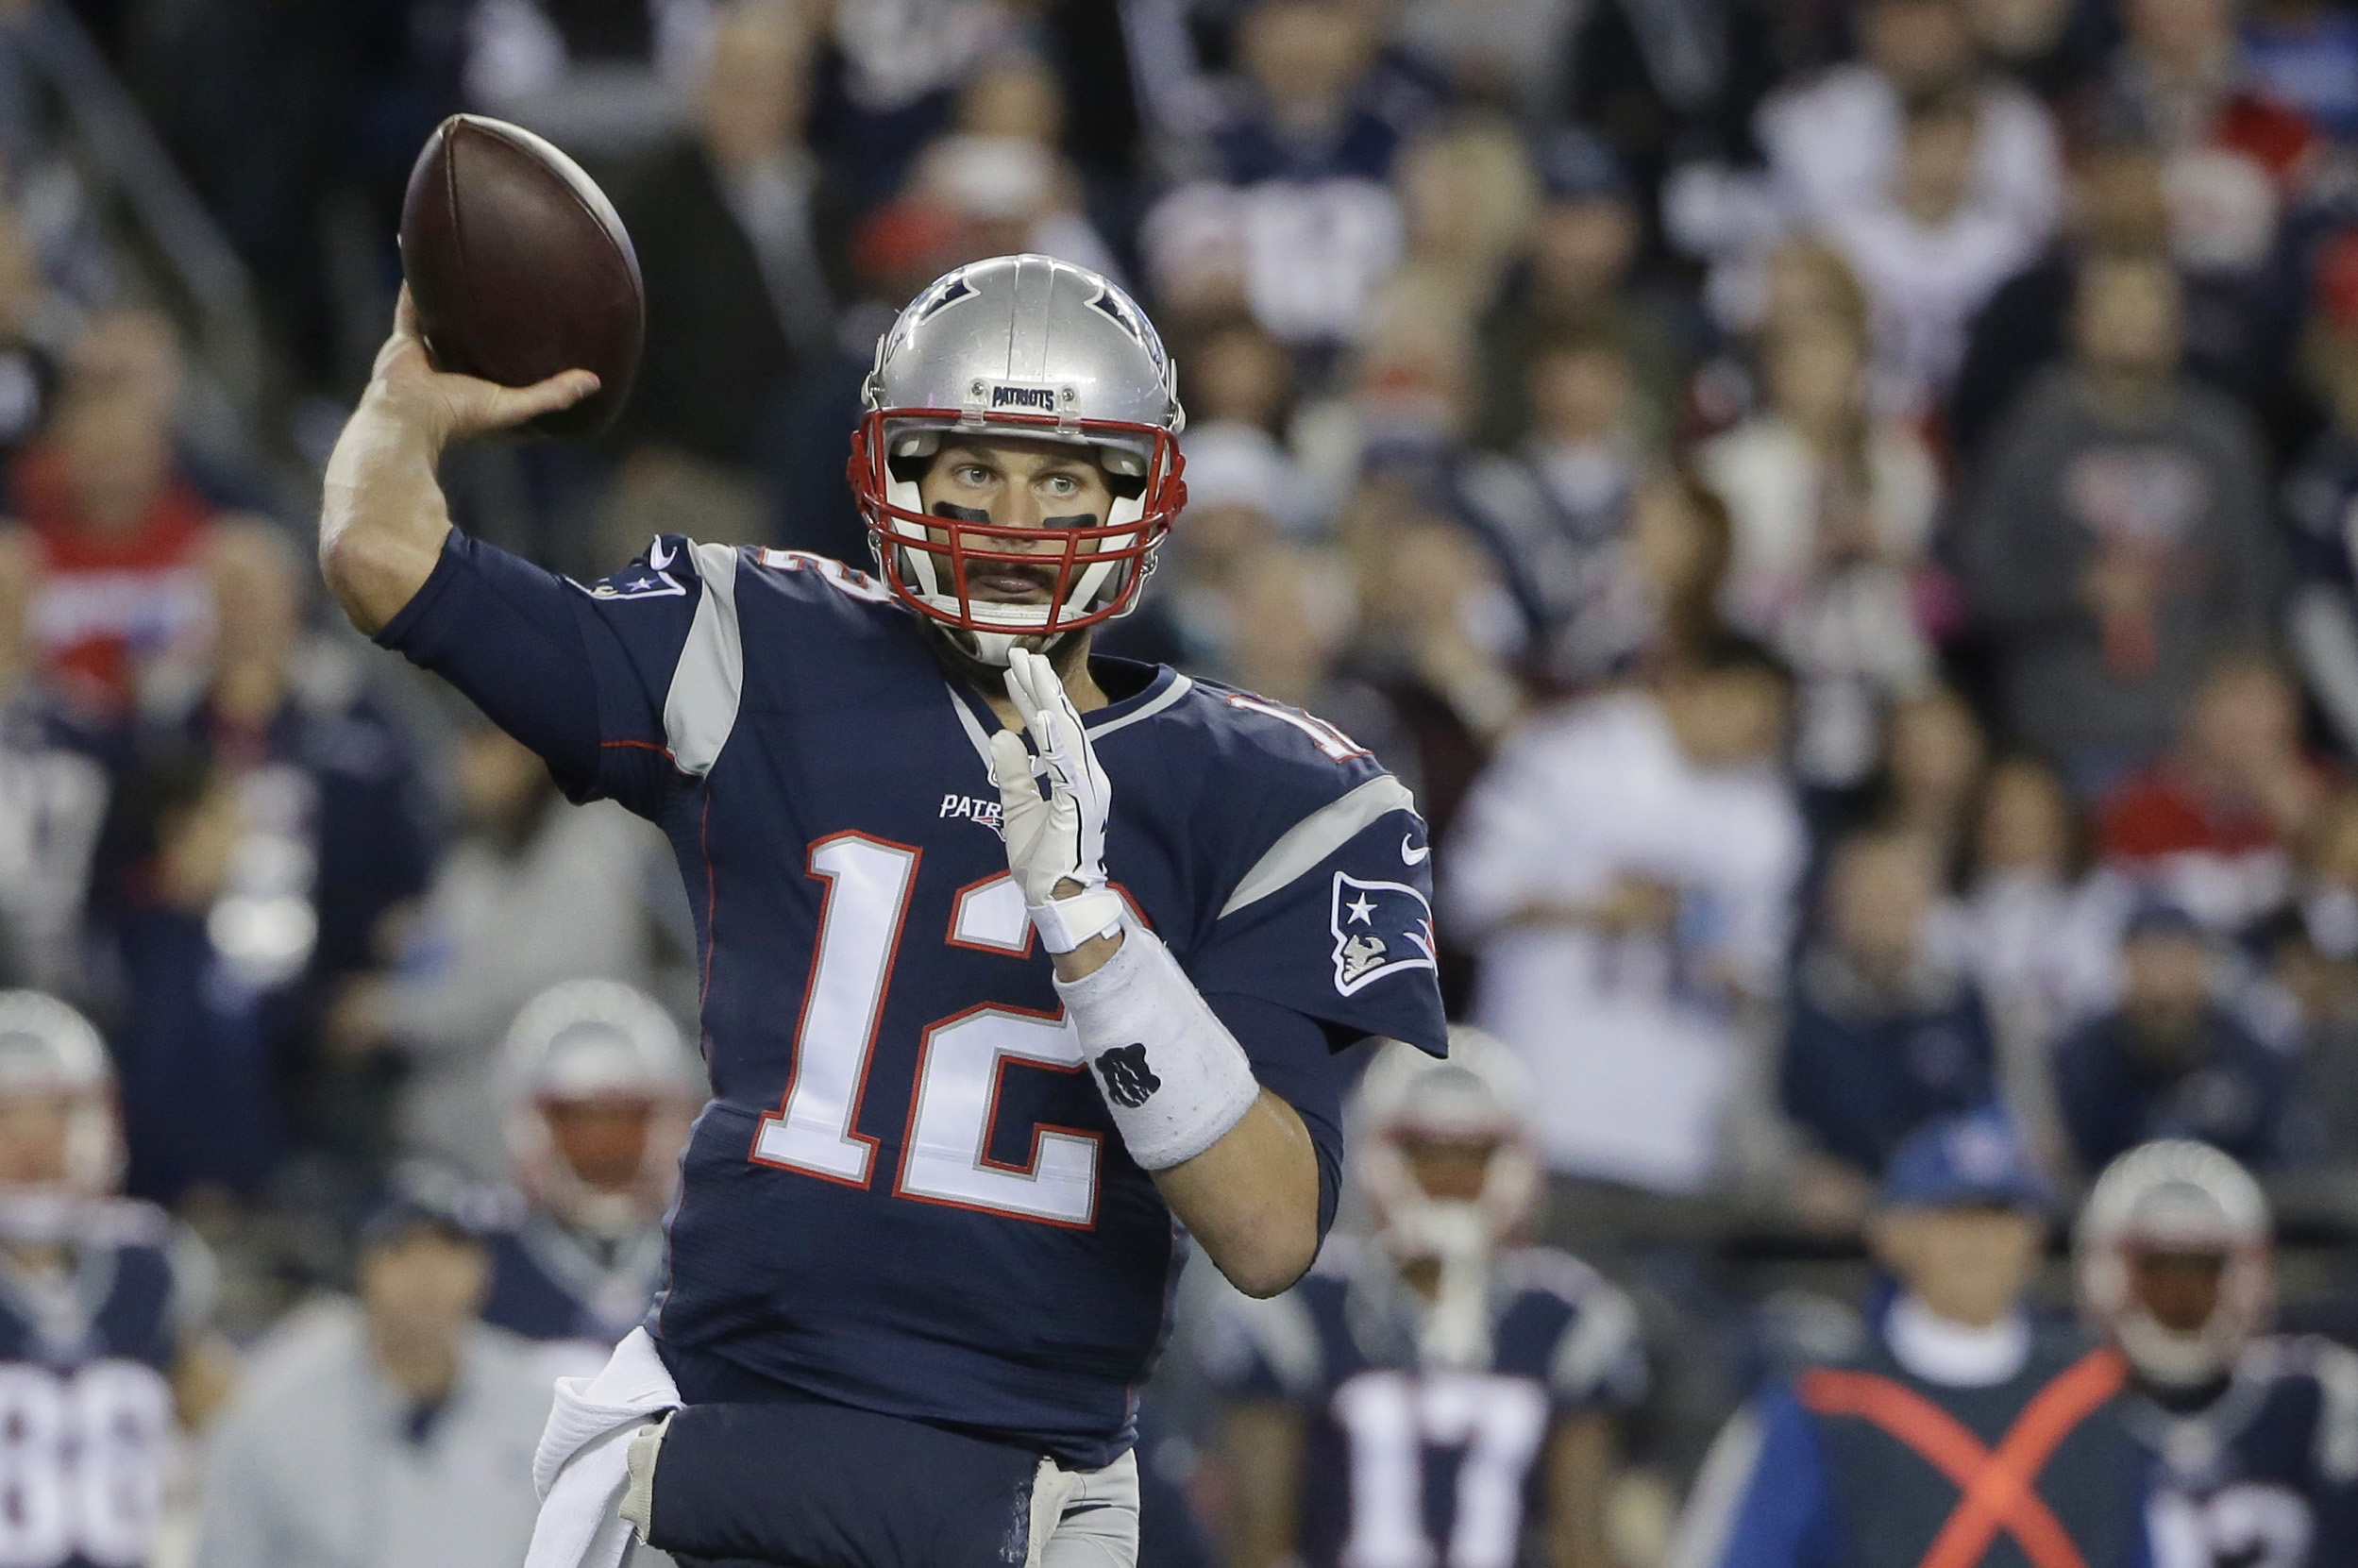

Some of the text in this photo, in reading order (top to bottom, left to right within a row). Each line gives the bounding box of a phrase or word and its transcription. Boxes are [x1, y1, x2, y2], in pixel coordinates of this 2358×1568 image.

[992, 386, 1054, 412] PATRIOTS
[1226, 691, 1373, 763] 1
[749, 829, 1154, 1231] 12
[1328, 1371, 1554, 1568] 17
